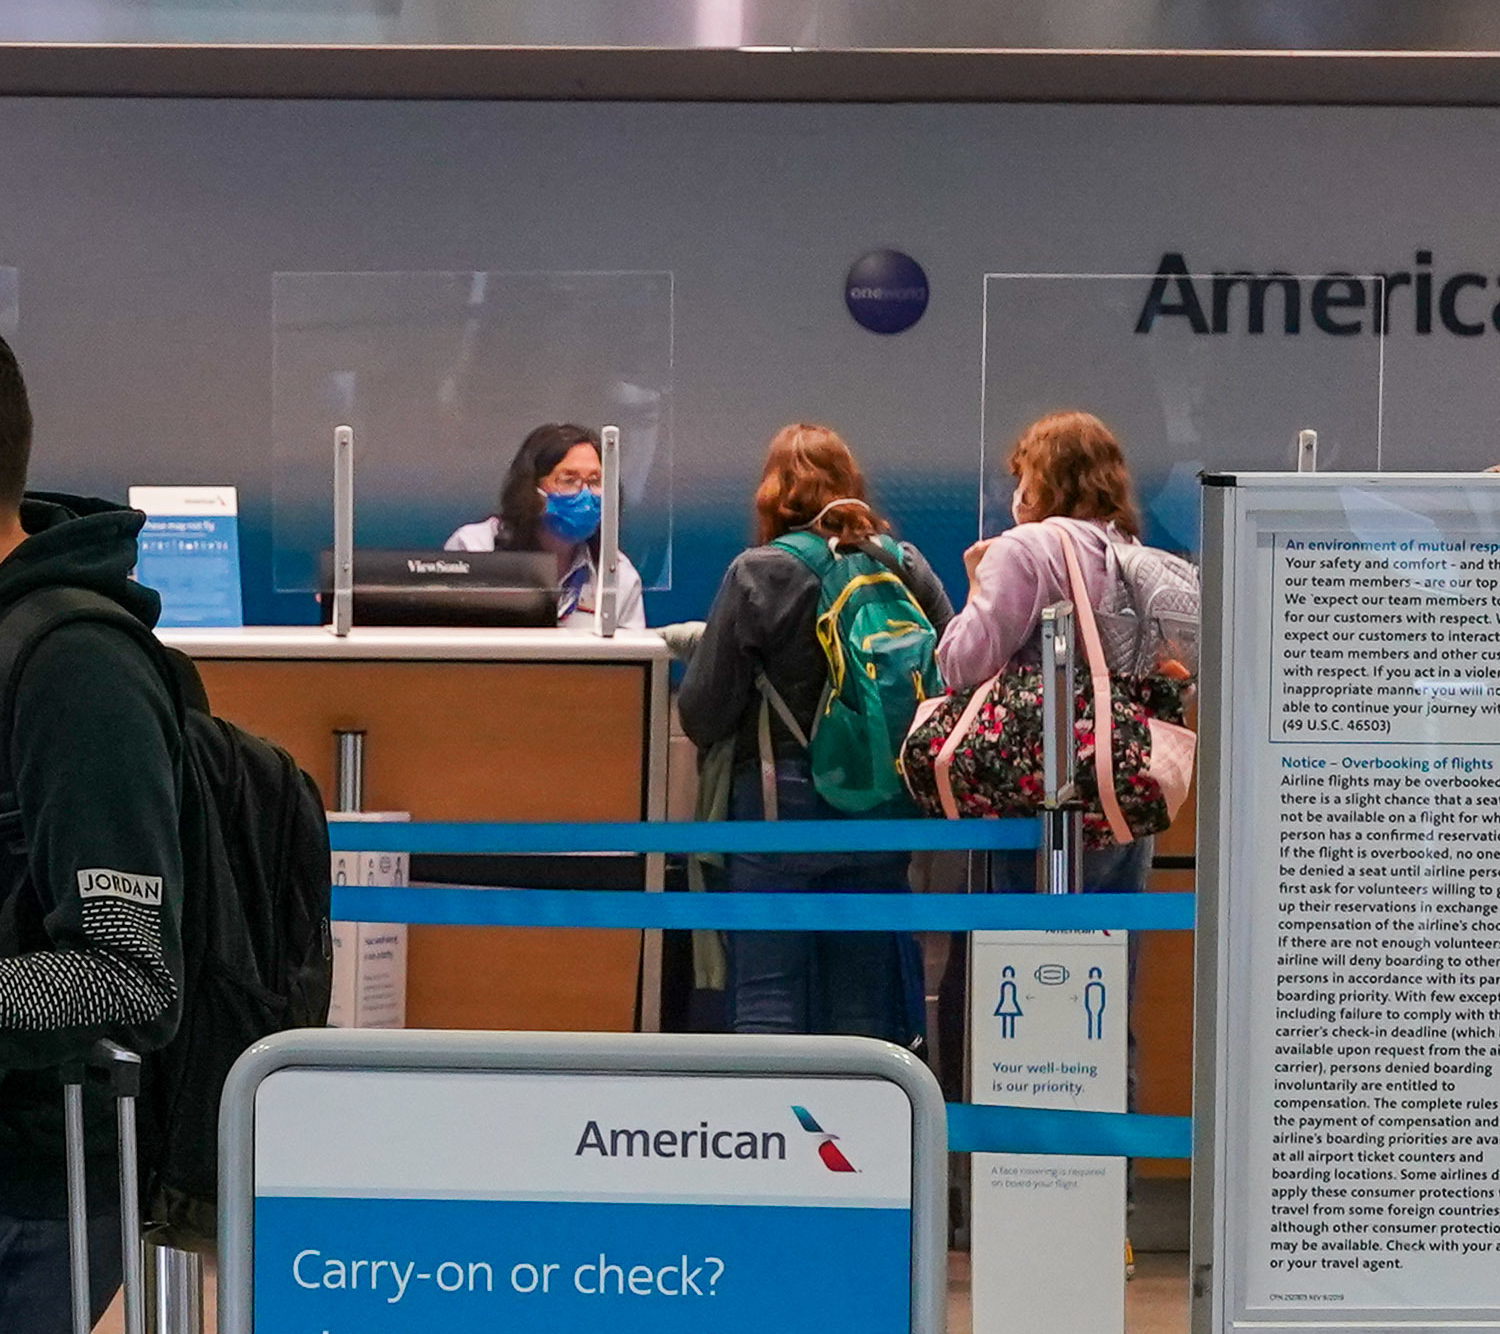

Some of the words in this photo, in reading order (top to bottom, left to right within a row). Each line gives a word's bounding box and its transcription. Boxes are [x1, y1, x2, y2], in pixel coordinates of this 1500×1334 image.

[1285, 538, 1304, 550] An
[1308, 538, 1396, 551] environment
[1399, 539, 1414, 550] of
[1418, 539, 1466, 551] mutual
[1284, 610, 1304, 623] for
[1307, 614, 1330, 622] our
[1333, 612, 1402, 623] customers
[1406, 611, 1436, 624] with
[1439, 613, 1492, 627] respect.
[1281, 756, 1326, 768] Notice
[1341, 756, 1429, 772] Overbooking
[1433, 756, 1448, 769] of
[1451, 756, 1493, 773] flights
[83, 872, 160, 900] JORDAN
[992, 1061, 1023, 1073] Your
[1026, 1061, 1097, 1078] well-being
[992, 1079, 1002, 1091] is
[1006, 1082, 1029, 1092] our
[1032, 1080, 1085, 1096] priority.
[574, 1120, 786, 1160] American
[1271, 1203, 1309, 1215] travel
[1312, 1202, 1345, 1215] from
[1348, 1206, 1384, 1215] some
[1387, 1203, 1435, 1219] foreign
[1270, 1220, 1329, 1236] although
[1332, 1221, 1369, 1233] other
[1372, 1224, 1437, 1234] consumer
[1269, 1259, 1284, 1268] or
[1286, 1259, 1317, 1272] your
[1321, 1256, 1359, 1269] travel
[1362, 1258, 1403, 1272] agent.
[292, 1249, 492, 1303] Carry-on
[510, 1263, 560, 1293] or
[573, 1253, 724, 1296] check?
